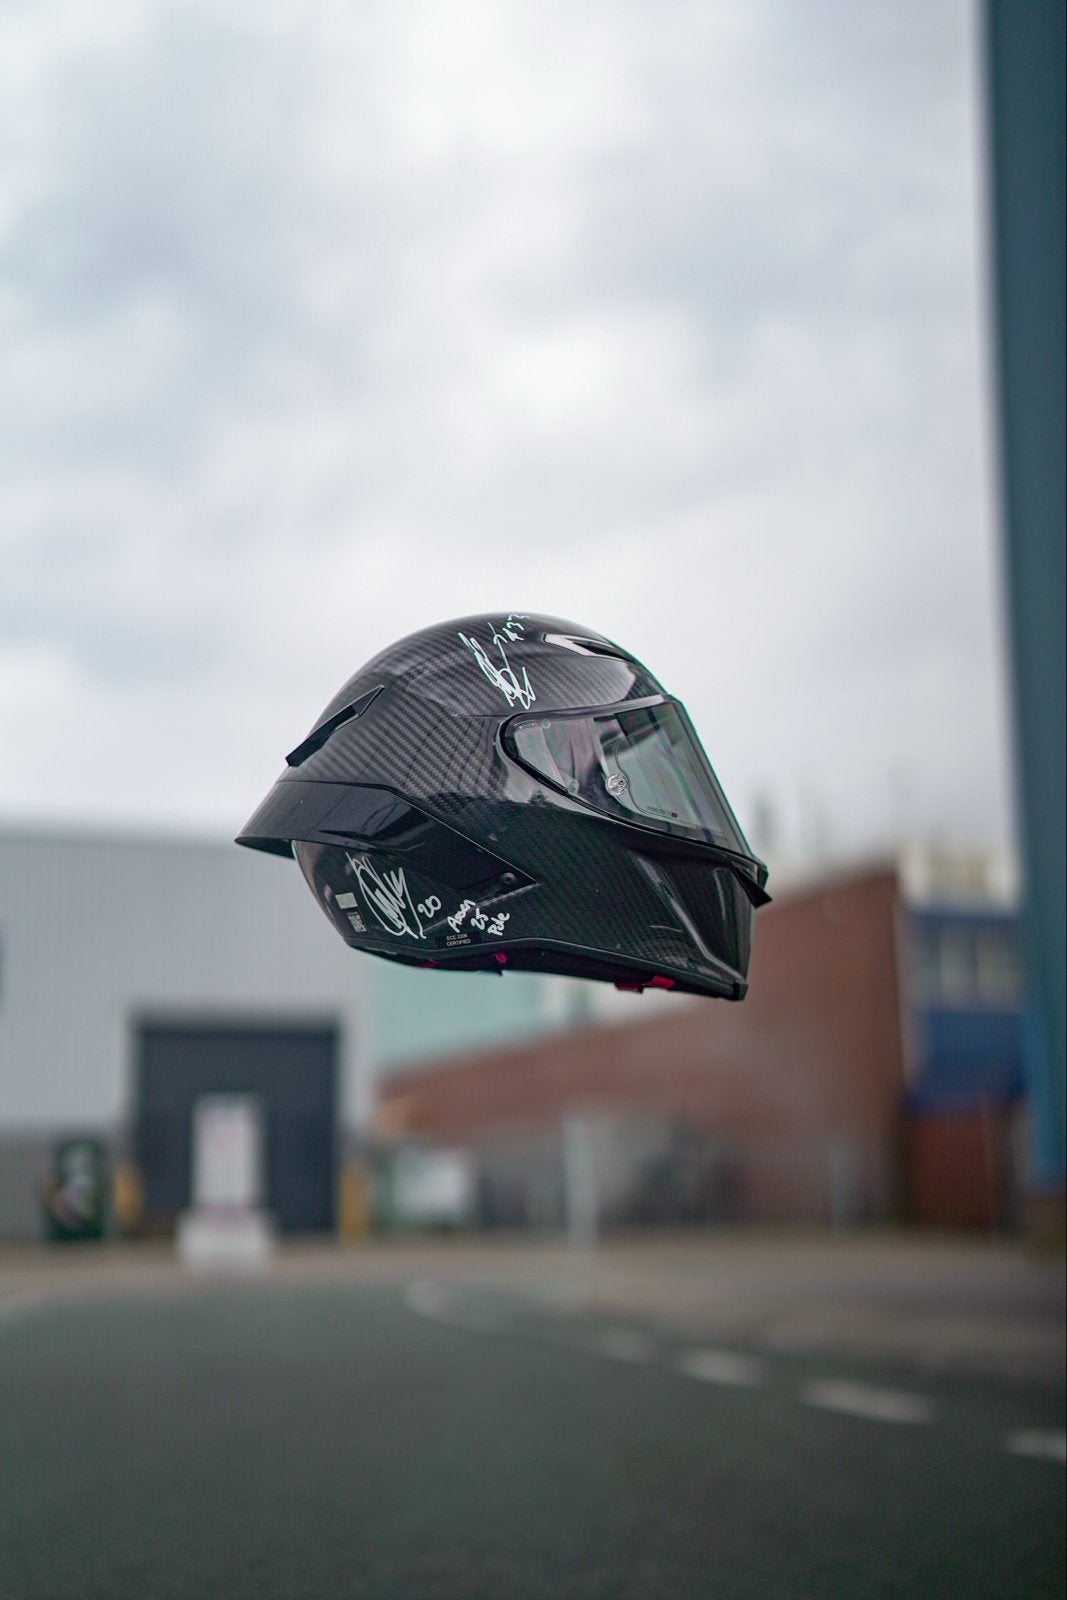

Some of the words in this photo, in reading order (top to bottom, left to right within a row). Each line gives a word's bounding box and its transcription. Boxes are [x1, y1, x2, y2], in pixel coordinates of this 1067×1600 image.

[417, 895, 442, 918] 20
[470, 907, 489, 930] 25
[446, 938, 471, 947] CERTIFIED
